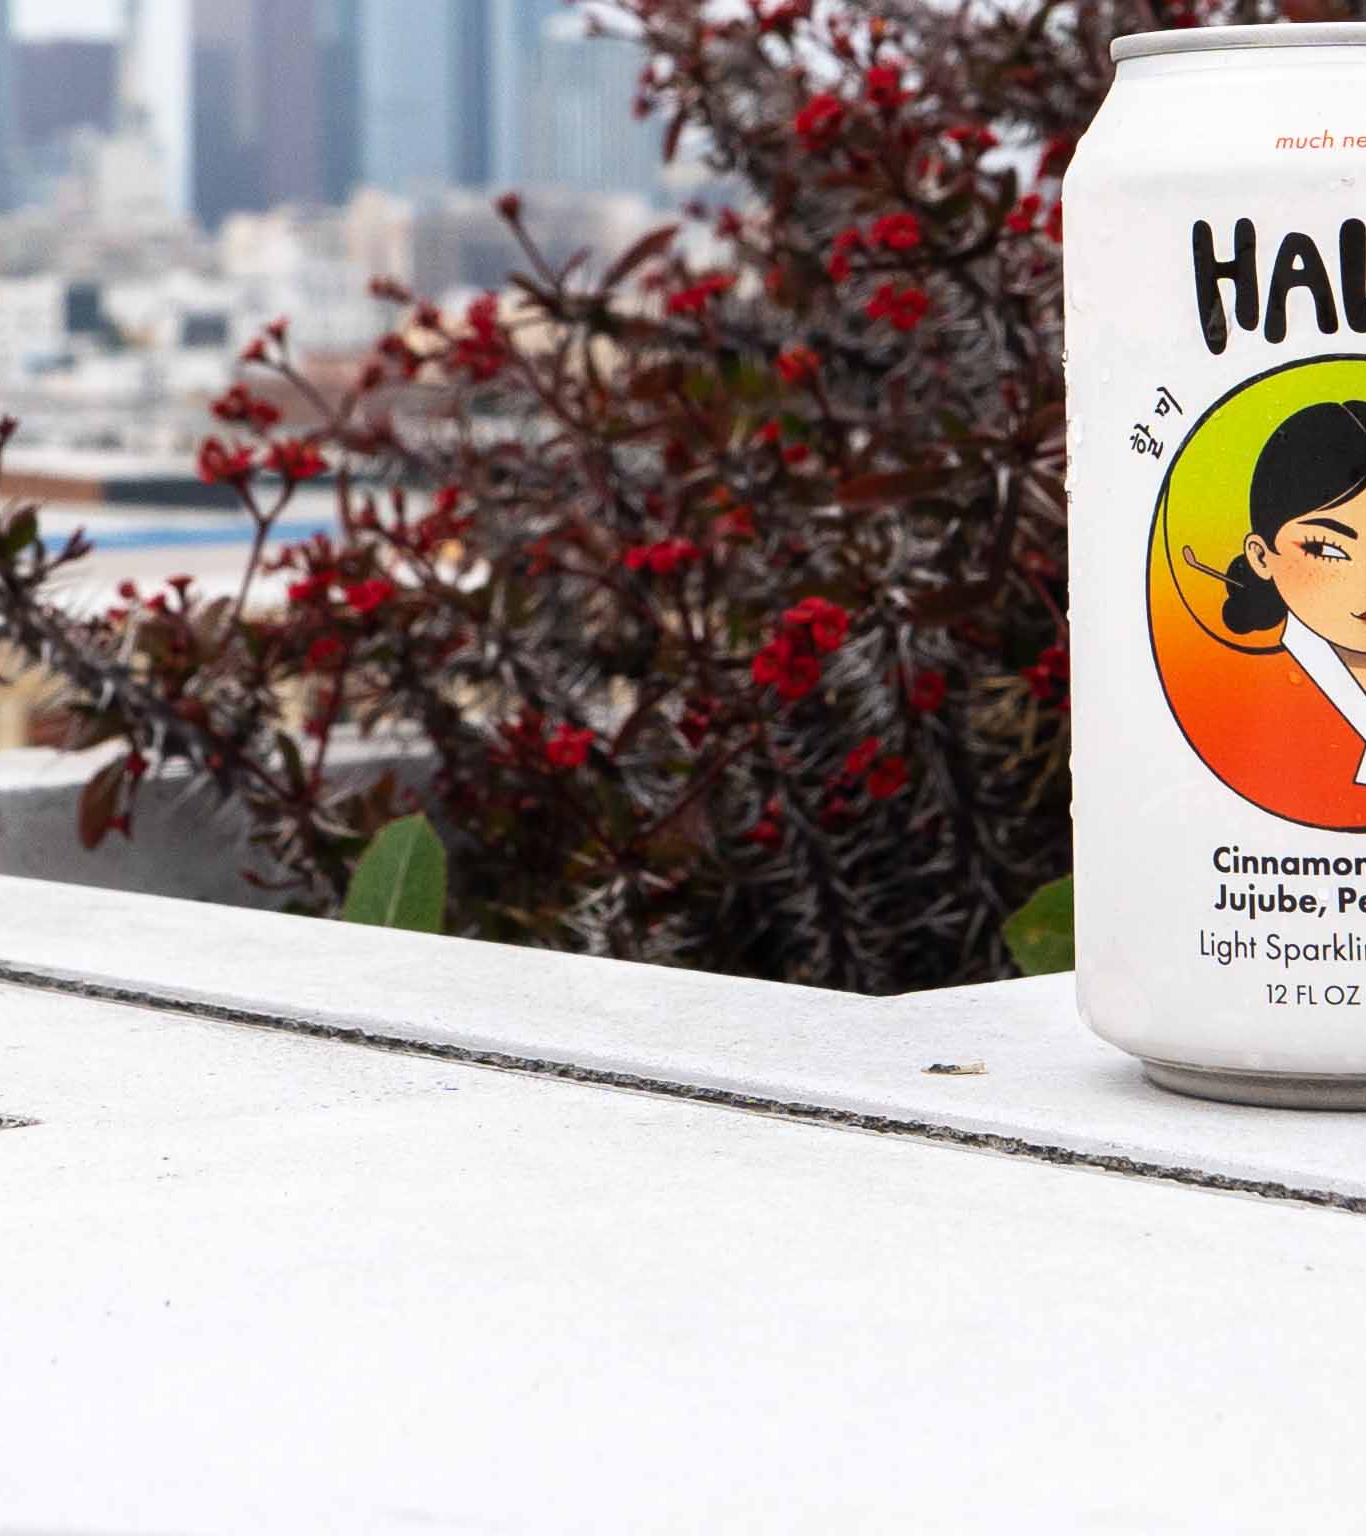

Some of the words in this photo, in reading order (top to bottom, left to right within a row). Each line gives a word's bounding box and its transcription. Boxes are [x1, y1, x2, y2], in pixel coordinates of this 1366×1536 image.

[1275, 129, 1334, 149] much
[1213, 883, 1327, 921] Jujube,
[1200, 929, 1258, 966] Light
[1266, 983, 1288, 1005] 12
[1296, 984, 1318, 1006] FL
[1324, 985, 1362, 1006] OZ
